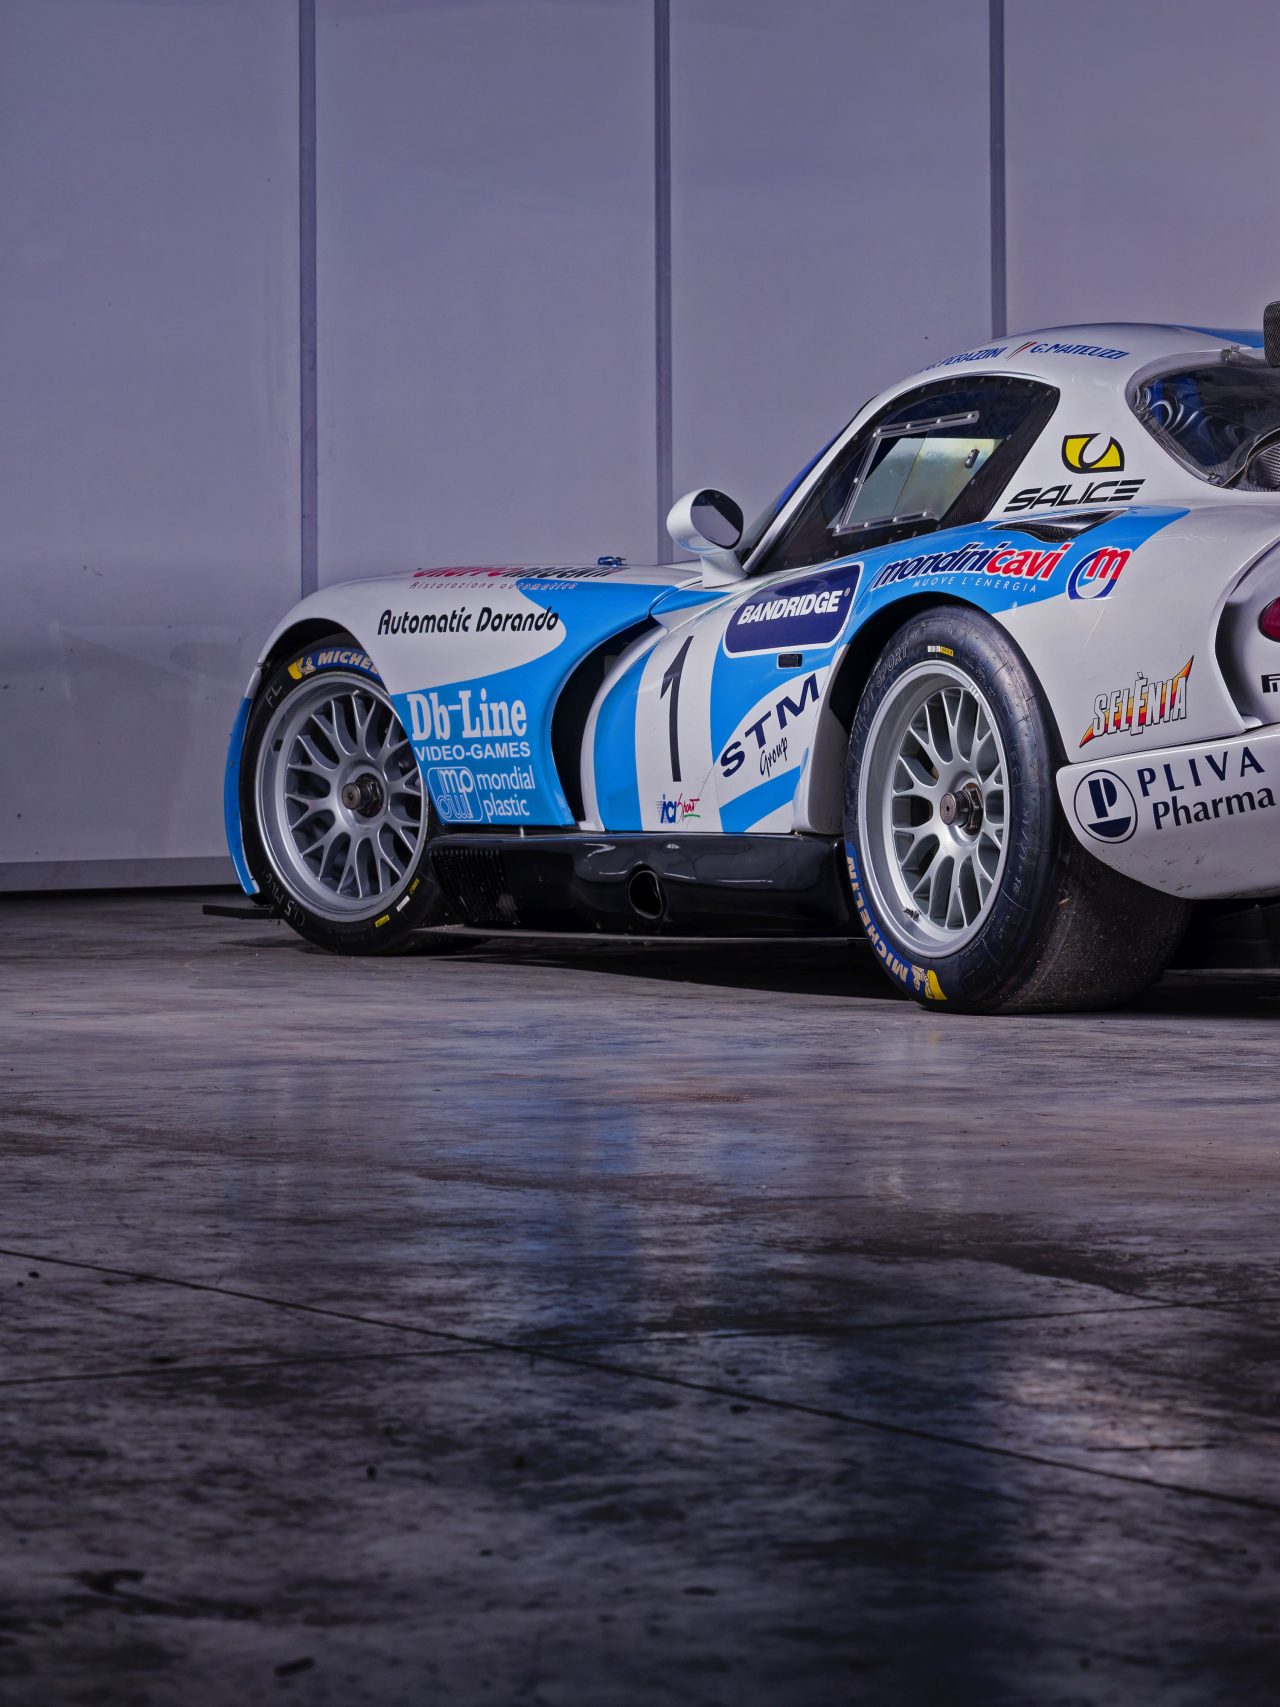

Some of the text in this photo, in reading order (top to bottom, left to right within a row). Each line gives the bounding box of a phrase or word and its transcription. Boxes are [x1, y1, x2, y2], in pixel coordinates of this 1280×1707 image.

[1003, 479, 1146, 512] SALICE
[870, 542, 1074, 591] mondinicavi
[913, 577, 1037, 593] MUOVE L'ENERGIA
[377, 606, 559, 635] Automatic Dorando
[737, 590, 844, 625] BANDRIDGE
[406, 688, 528, 741] Db-Line
[660, 635, 695, 783] 1
[719, 672, 821, 778] STM
[414, 741, 531, 762] VIDEO-GAMES
[759, 736, 789, 778] Group
[1136, 746, 1267, 798] PLIVA
[476, 764, 536, 791] mondial
[483, 791, 530, 824] plastic
[1151, 786, 1277, 831] Pharma
[846, 856, 909, 983] MICHELIN
